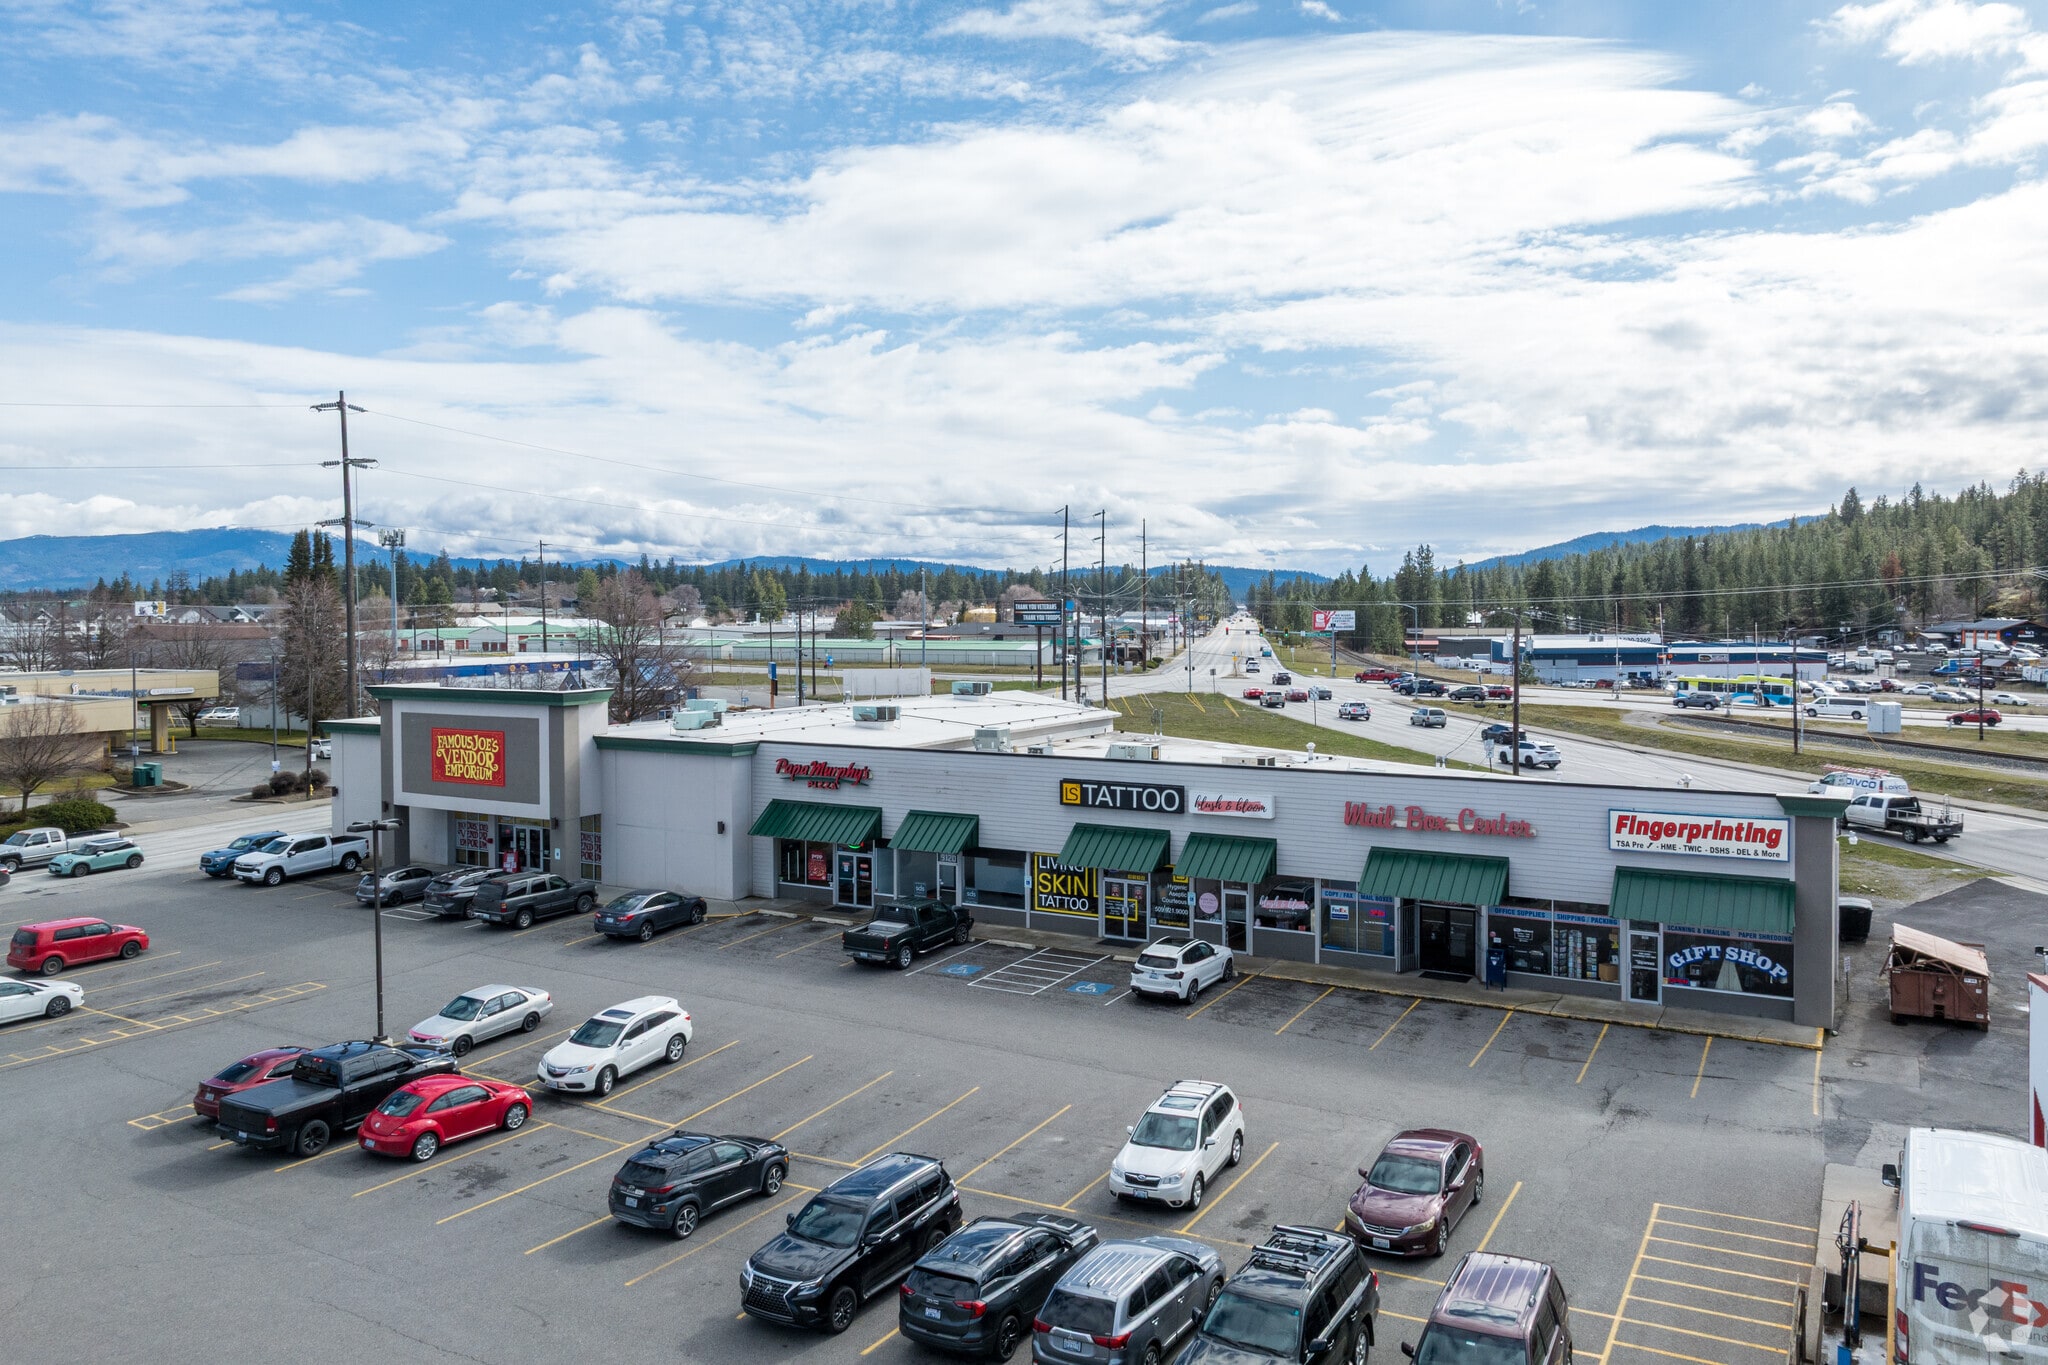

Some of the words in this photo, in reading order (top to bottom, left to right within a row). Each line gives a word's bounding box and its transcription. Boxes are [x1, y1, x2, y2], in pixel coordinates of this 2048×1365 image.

[436, 749, 498, 771] VENDOR
[445, 764, 493, 780] EMPORIUM
[775, 758, 809, 781] Papa
[810, 761, 871, 786] Murphy's
[807, 781, 839, 790] PIZZA
[1065, 787, 1079, 801] LS
[1082, 784, 1180, 812] TATTOO
[1194, 795, 1222, 811] blush
[1226, 800, 1233, 810] &
[1235, 798, 1267, 813] bloom
[1343, 801, 1397, 830] Mail
[1404, 805, 1449, 832] Box
[1457, 808, 1536, 838] Center
[1615, 814, 1783, 849] Fingerprinting
[1616, 840, 1630, 848] TSA
[1632, 841, 1644, 849] Pre
[1661, 843, 1677, 851] HME
[1683, 845, 1702, 853] TWIC
[1709, 846, 1730, 854] DSHS
[1736, 848, 1751, 856] DEL
[1761, 850, 1781, 858] More
[941, 854, 957, 862] 9120
[915, 884, 925, 892] sds
[1038, 872, 1088, 897] SKIN
[1039, 894, 1089, 911] TATTOO
[1161, 897, 1188, 905] Courteous
[1494, 907, 1515, 916] OFFICE
[1516, 909, 1546, 918] SUPPLIES
[1556, 913, 1585, 922] SHIPPING
[1590, 917, 1618, 925] PACKING
[1667, 925, 1696, 934] SCANNING
[1702, 928, 1730, 937] EMAILING
[1738, 931, 1757, 939] PAPER
[1758, 933, 1793, 942] SHREDDING
[1669, 945, 1721, 969] GIFT
[1724, 946, 1788, 979] SHOP
